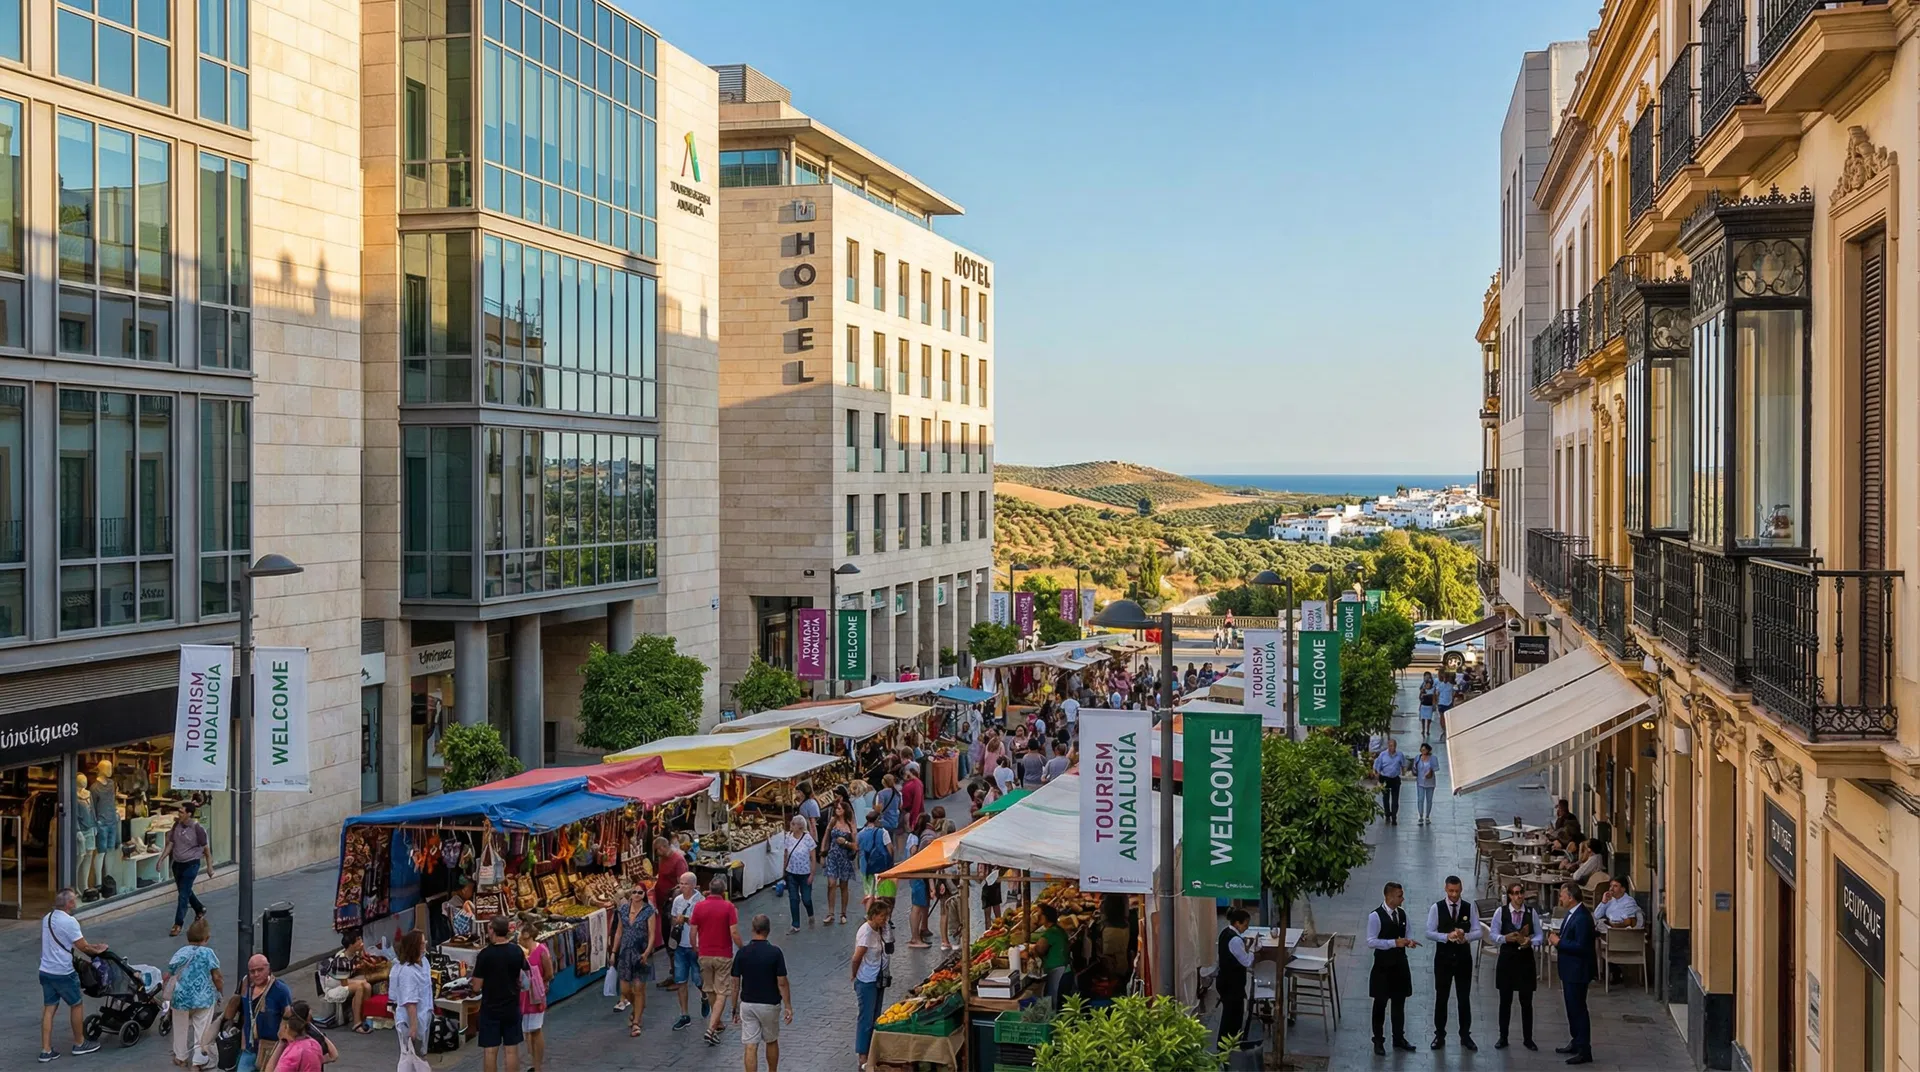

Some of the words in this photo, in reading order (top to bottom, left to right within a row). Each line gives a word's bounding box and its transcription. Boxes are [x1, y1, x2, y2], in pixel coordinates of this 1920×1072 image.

[794, 232, 817, 383] HOTEL
[954, 251, 991, 289] HOTEL
[847, 615, 858, 669] WELCOME
[1253, 646, 1263, 698] TOURISM
[1264, 641, 1276, 707] ANDALUCÍA
[1313, 639, 1326, 710] WELCOME
[185, 672, 204, 751] TOURISM
[203, 664, 222, 765] ANDALUCÍA
[272, 661, 289, 765] WELCOME
[1095, 743, 1114, 843] TOURISM
[1114, 732, 1137, 861] ANDALUCÍA
[1210, 729, 1234, 866] WELCOME
